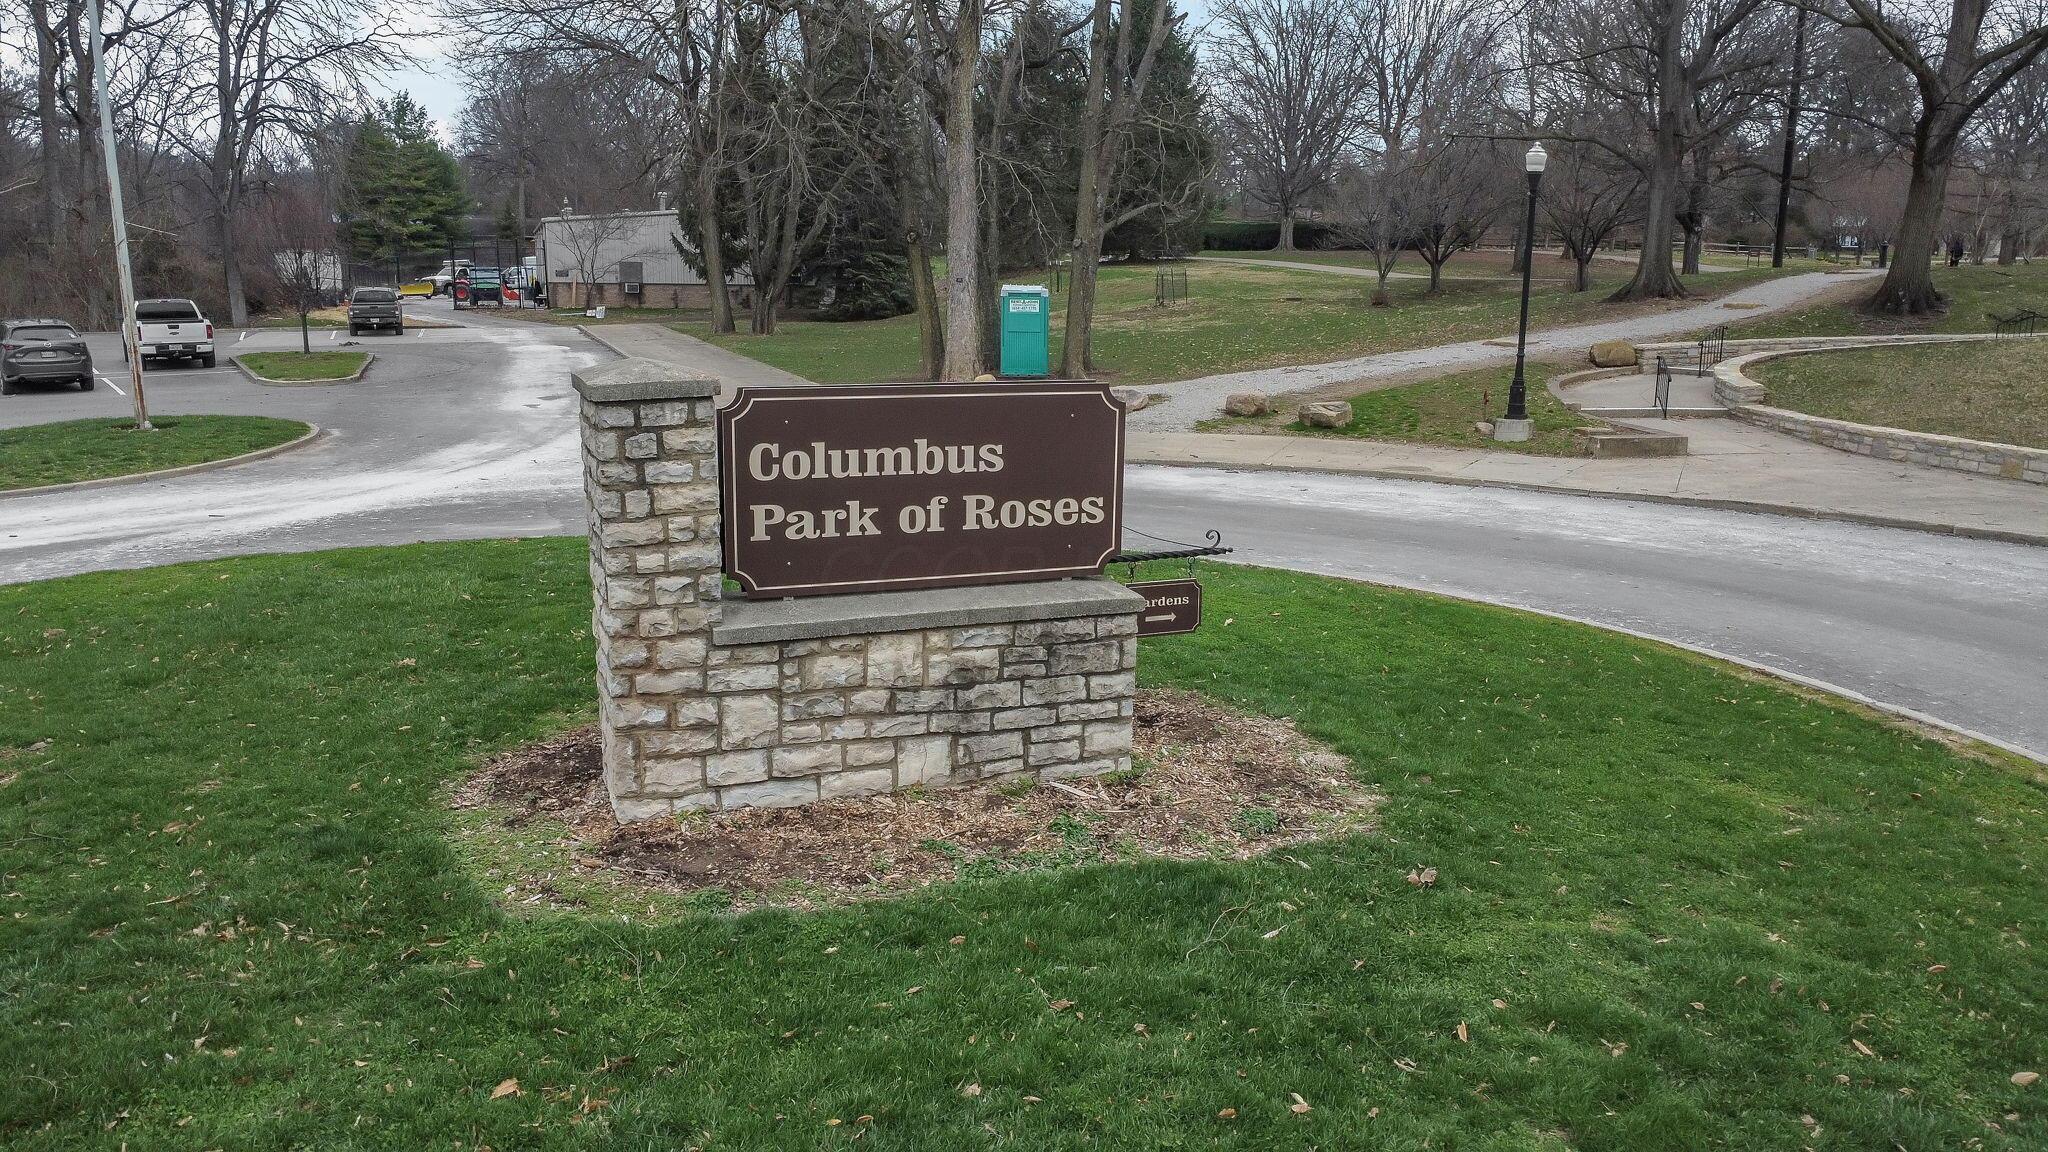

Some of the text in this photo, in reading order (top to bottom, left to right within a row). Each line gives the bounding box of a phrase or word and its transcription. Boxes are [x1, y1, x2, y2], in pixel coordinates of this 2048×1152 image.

[748, 438, 1005, 481] Columbus
[749, 493, 1106, 542] Park of Roses
[1144, 596, 1189, 608] ardens
